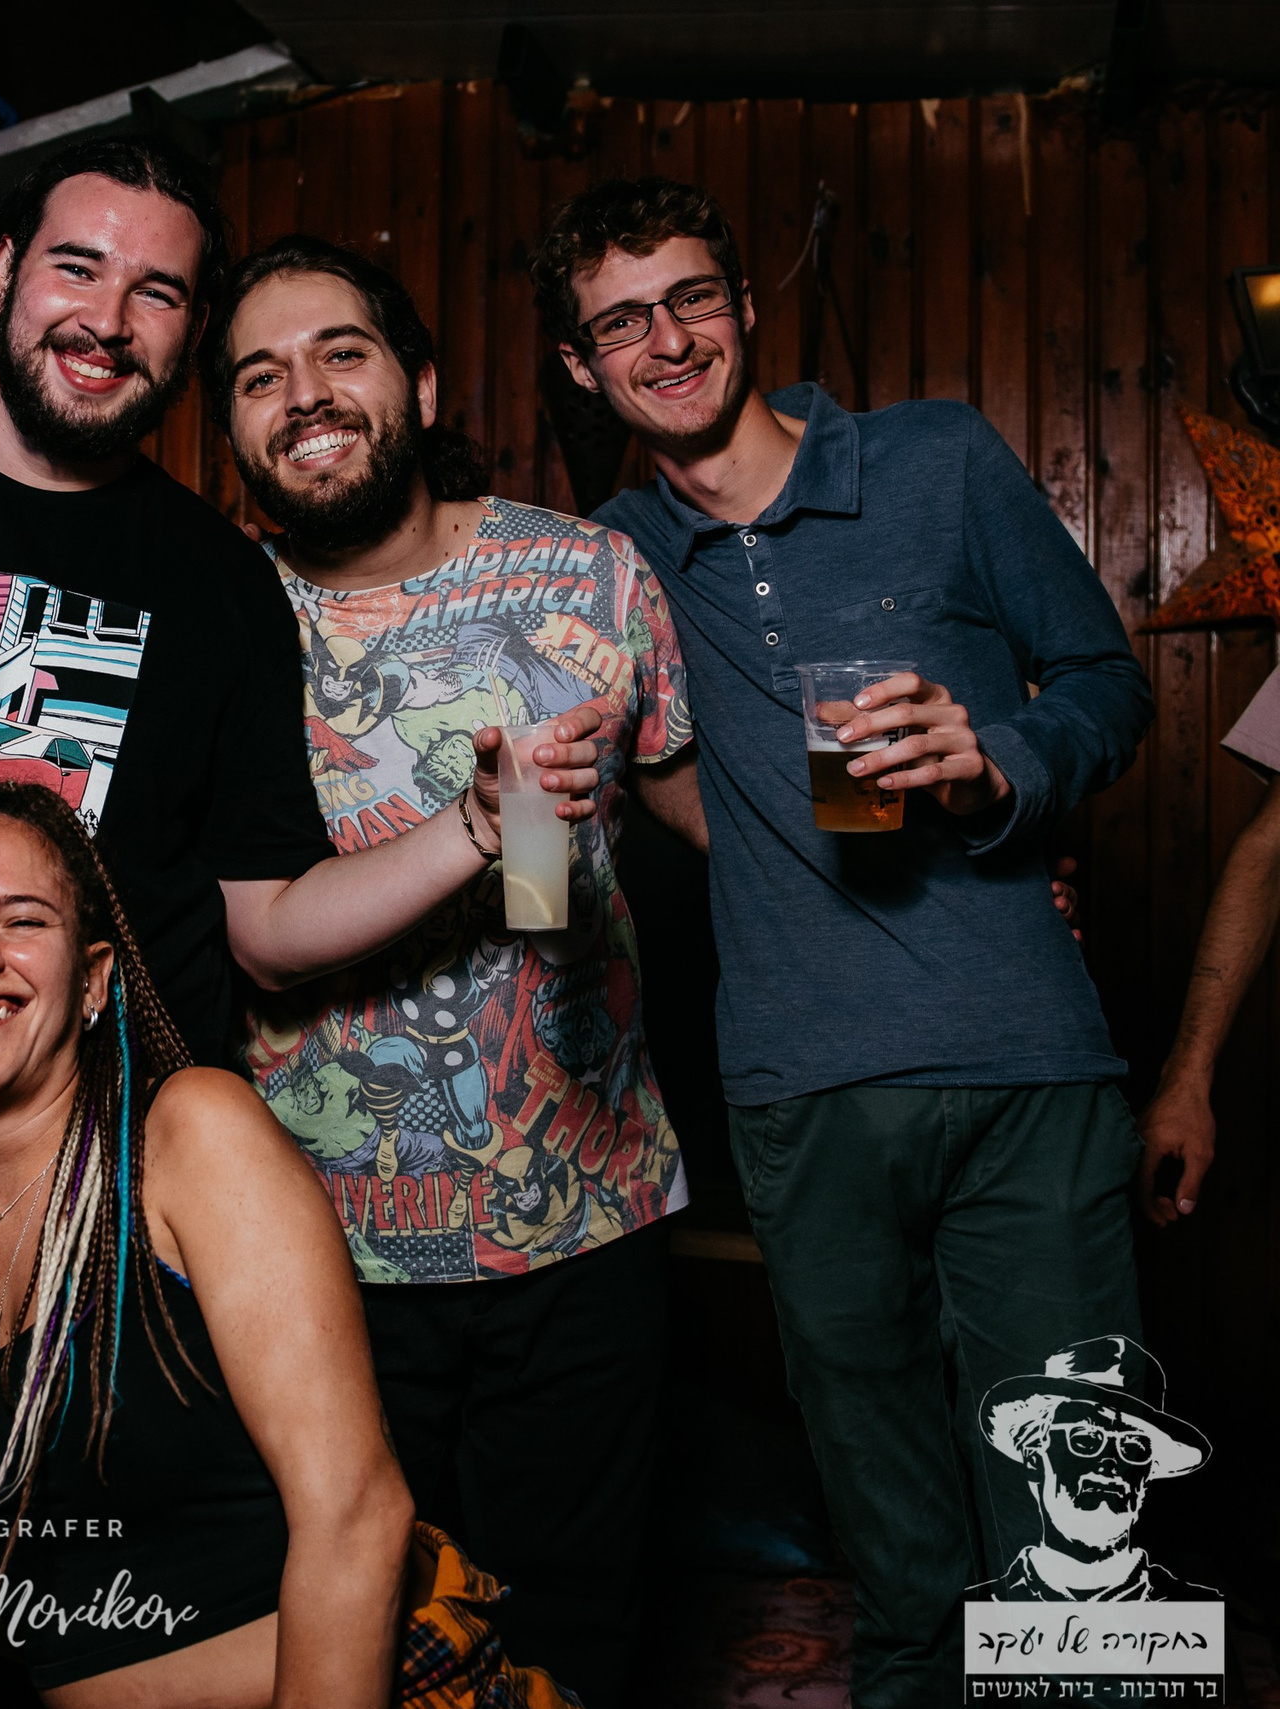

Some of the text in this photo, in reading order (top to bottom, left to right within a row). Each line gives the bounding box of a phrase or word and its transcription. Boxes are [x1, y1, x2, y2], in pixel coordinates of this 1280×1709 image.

[404, 575, 597, 635] AMERICA
[535, 643, 608, 695] INCREDIBLE
[536, 613, 633, 705] HULK
[530, 1066, 562, 1090] MIGHTY
[543, 1063, 557, 1076] THE
[513, 1076, 644, 1200] THOR
[317, 1169, 494, 1236] LVERINE
